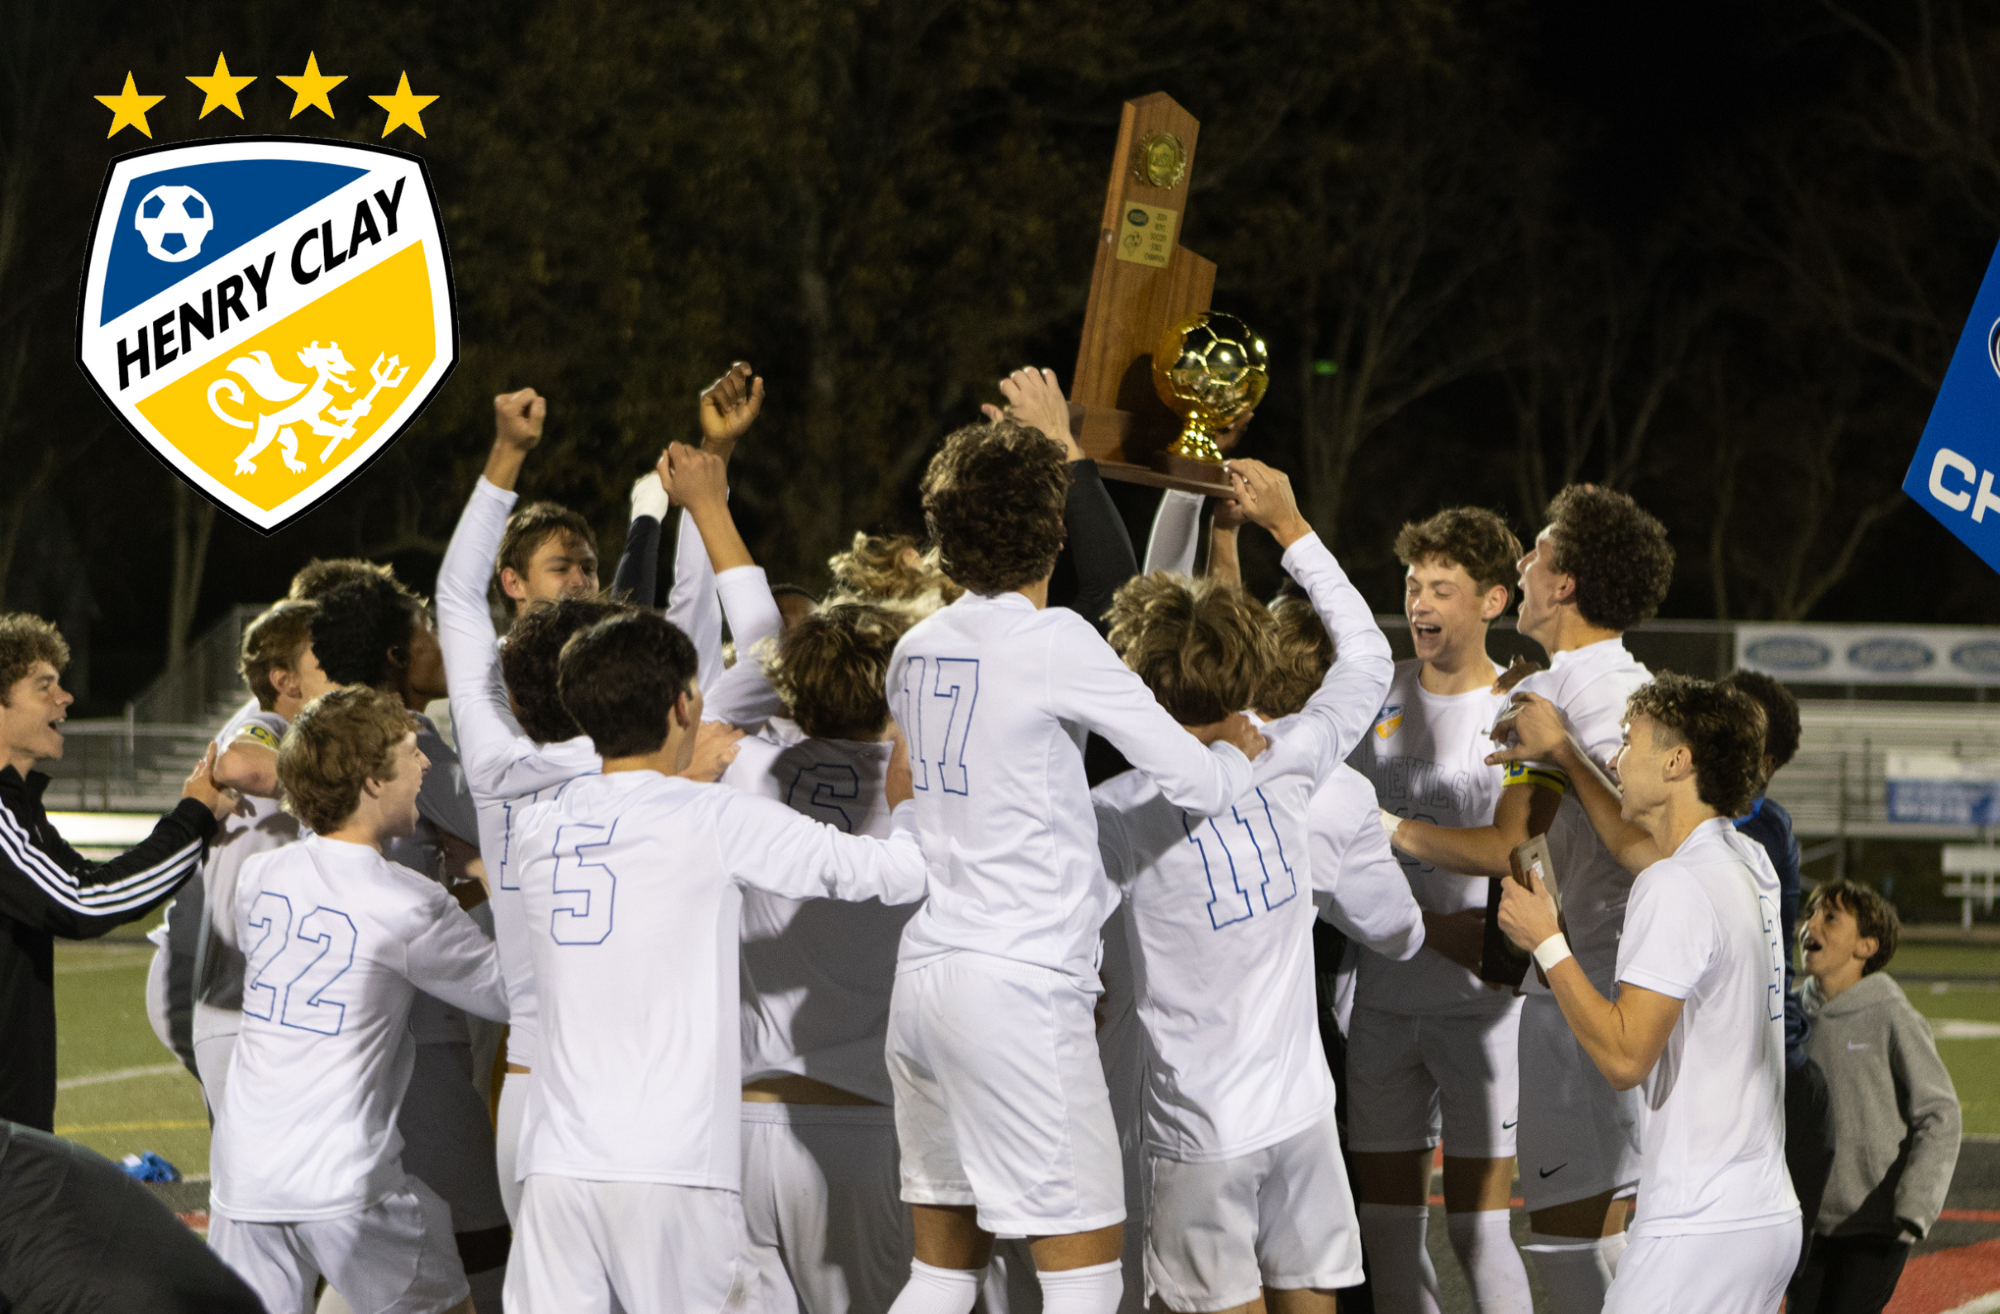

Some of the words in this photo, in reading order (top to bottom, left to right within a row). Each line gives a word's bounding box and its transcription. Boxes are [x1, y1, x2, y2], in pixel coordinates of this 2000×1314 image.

[904, 656, 979, 795] 17
[551, 816, 620, 945] 5
[1182, 787, 1296, 930] 11
[242, 891, 358, 1036] 22
